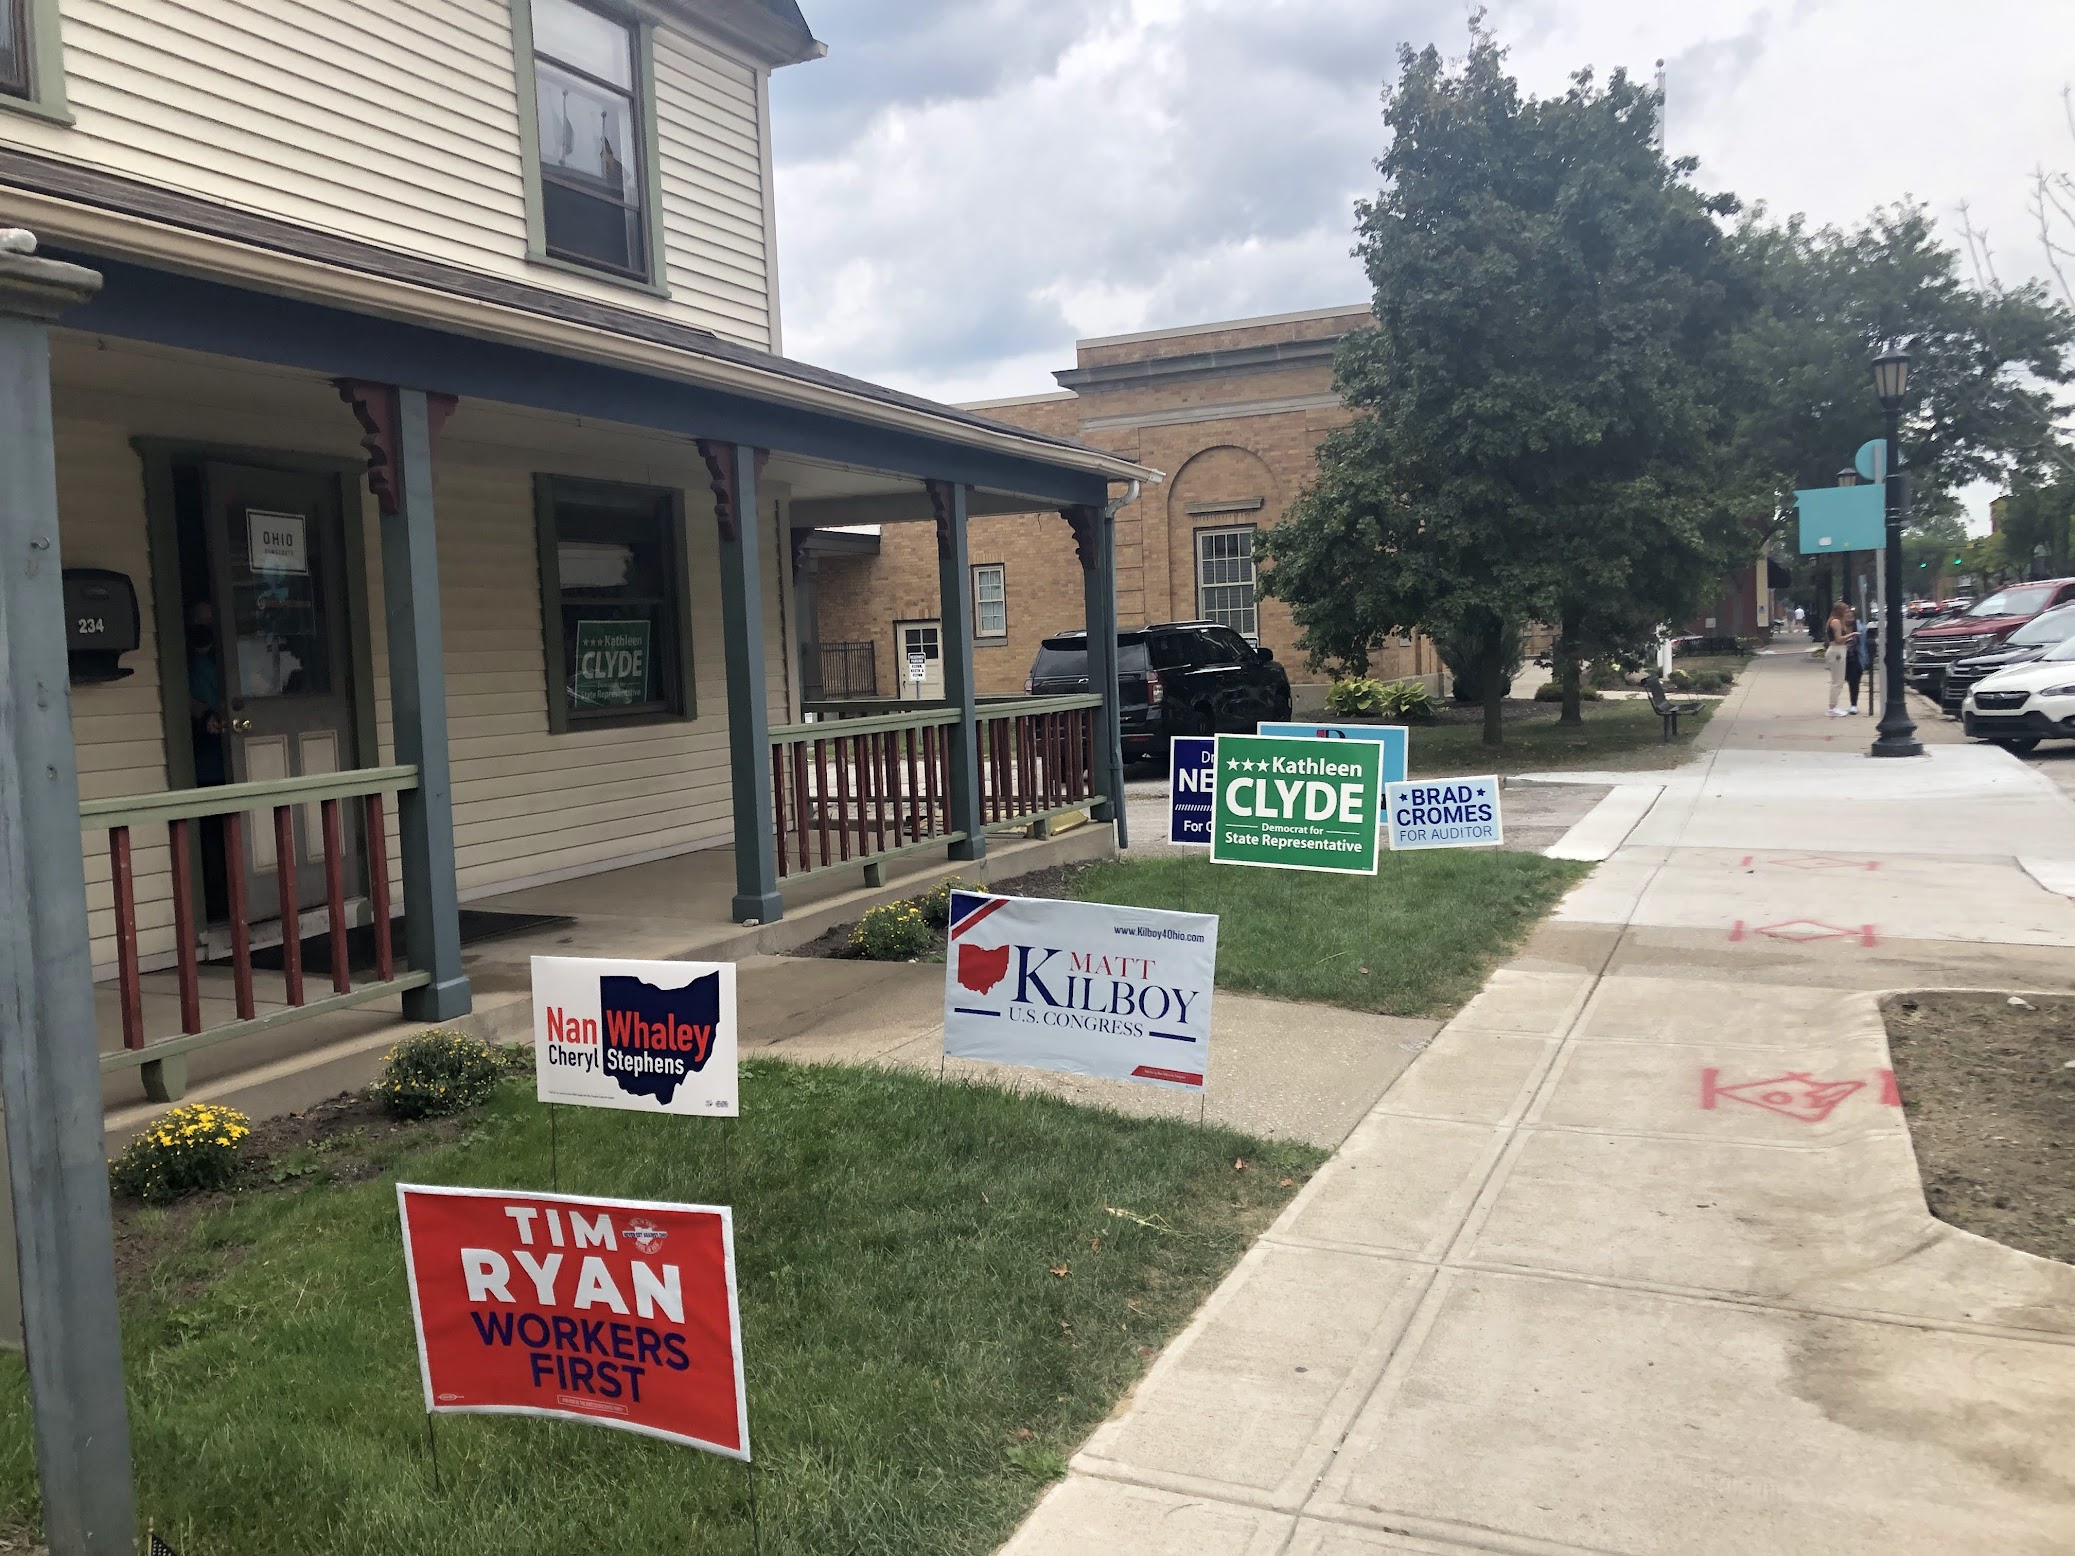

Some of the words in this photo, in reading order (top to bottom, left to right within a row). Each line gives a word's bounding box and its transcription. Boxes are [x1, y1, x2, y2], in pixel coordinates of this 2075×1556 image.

[263, 531, 293, 546] OHIO
[78, 618, 105, 634] 234
[604, 634, 643, 647] Kathleen
[581, 650, 643, 679] CLYDE
[1272, 756, 1362, 778] Kathleen
[1225, 777, 1365, 824] CLYDE
[1412, 786, 1473, 807] BRAD
[1183, 820, 1203, 832] For
[1397, 803, 1493, 826] CROMES
[1225, 832, 1260, 846] State
[1262, 834, 1363, 854] Representative
[1261, 823, 1308, 835] Democrat
[1309, 825, 1324, 836] for
[1400, 828, 1428, 842] FOR
[1431, 825, 1493, 841] AUDITOR
[1069, 951, 1156, 980] MATT
[1011, 945, 1199, 1024] KILBOY
[546, 1006, 598, 1045] Nan
[606, 1009, 711, 1062] Whaley
[1009, 1007, 1040, 1024] U.S.
[1043, 1011, 1143, 1038] CONGRESS
[549, 1044, 599, 1073] Cheryl
[607, 1048, 685, 1077] Stephens
[504, 1206, 618, 1251] TIM
[460, 1248, 685, 1324] RYAN
[470, 1311, 690, 1371] WORKERS
[529, 1353, 646, 1403] FIRST
